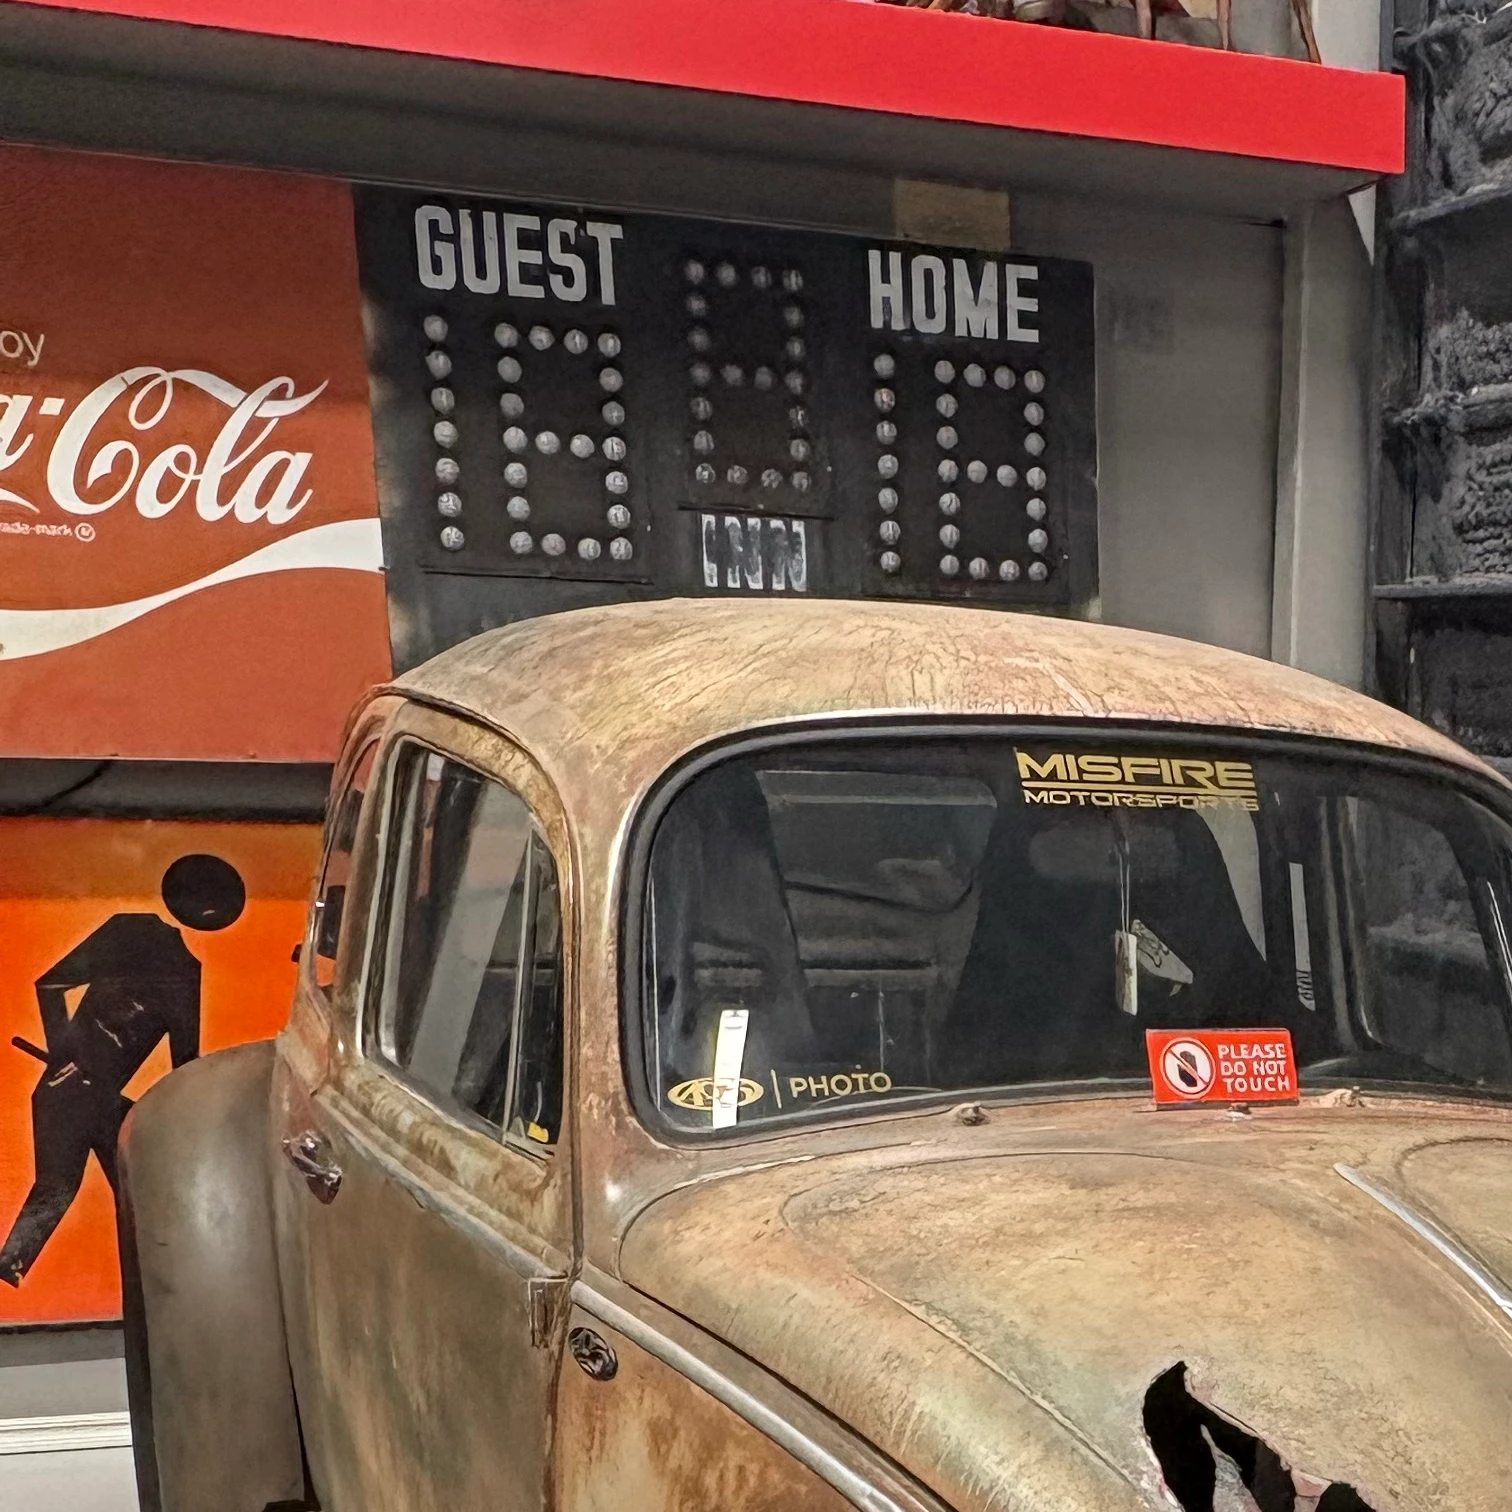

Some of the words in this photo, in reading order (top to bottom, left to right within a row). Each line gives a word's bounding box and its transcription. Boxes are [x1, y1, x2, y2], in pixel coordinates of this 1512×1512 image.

[415, 205, 623, 305] GUEST
[868, 249, 1039, 343] HOME
[1016, 751, 1257, 793] MISFIRE
[1023, 789, 1259, 811] MOTORSPORTS
[1217, 1043, 1287, 1059] PLEASE
[1221, 1061, 1247, 1076] DO
[1253, 1060, 1287, 1076] NOT
[789, 1071, 892, 1098] PHOTO
[1224, 1076, 1291, 1093] TOUCH
